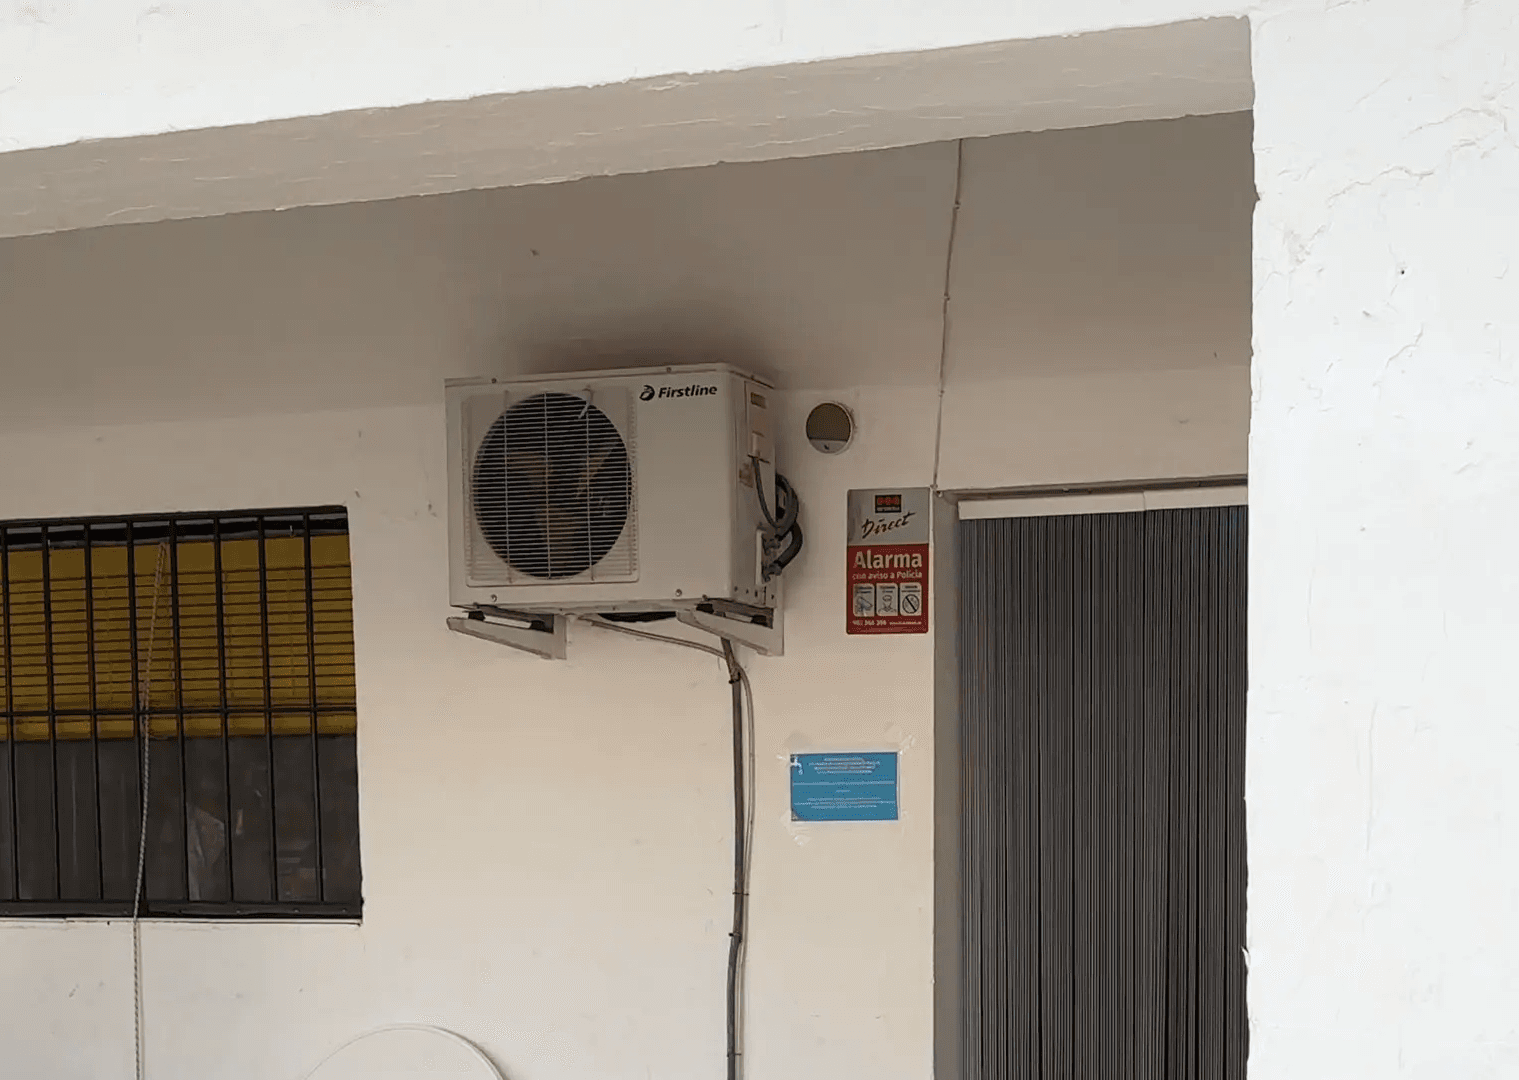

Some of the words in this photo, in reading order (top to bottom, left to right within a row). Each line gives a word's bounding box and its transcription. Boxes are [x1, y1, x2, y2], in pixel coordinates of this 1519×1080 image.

[657, 384, 718, 399] Firstline
[861, 511, 916, 539] Direct
[853, 549, 922, 568] Alarma
